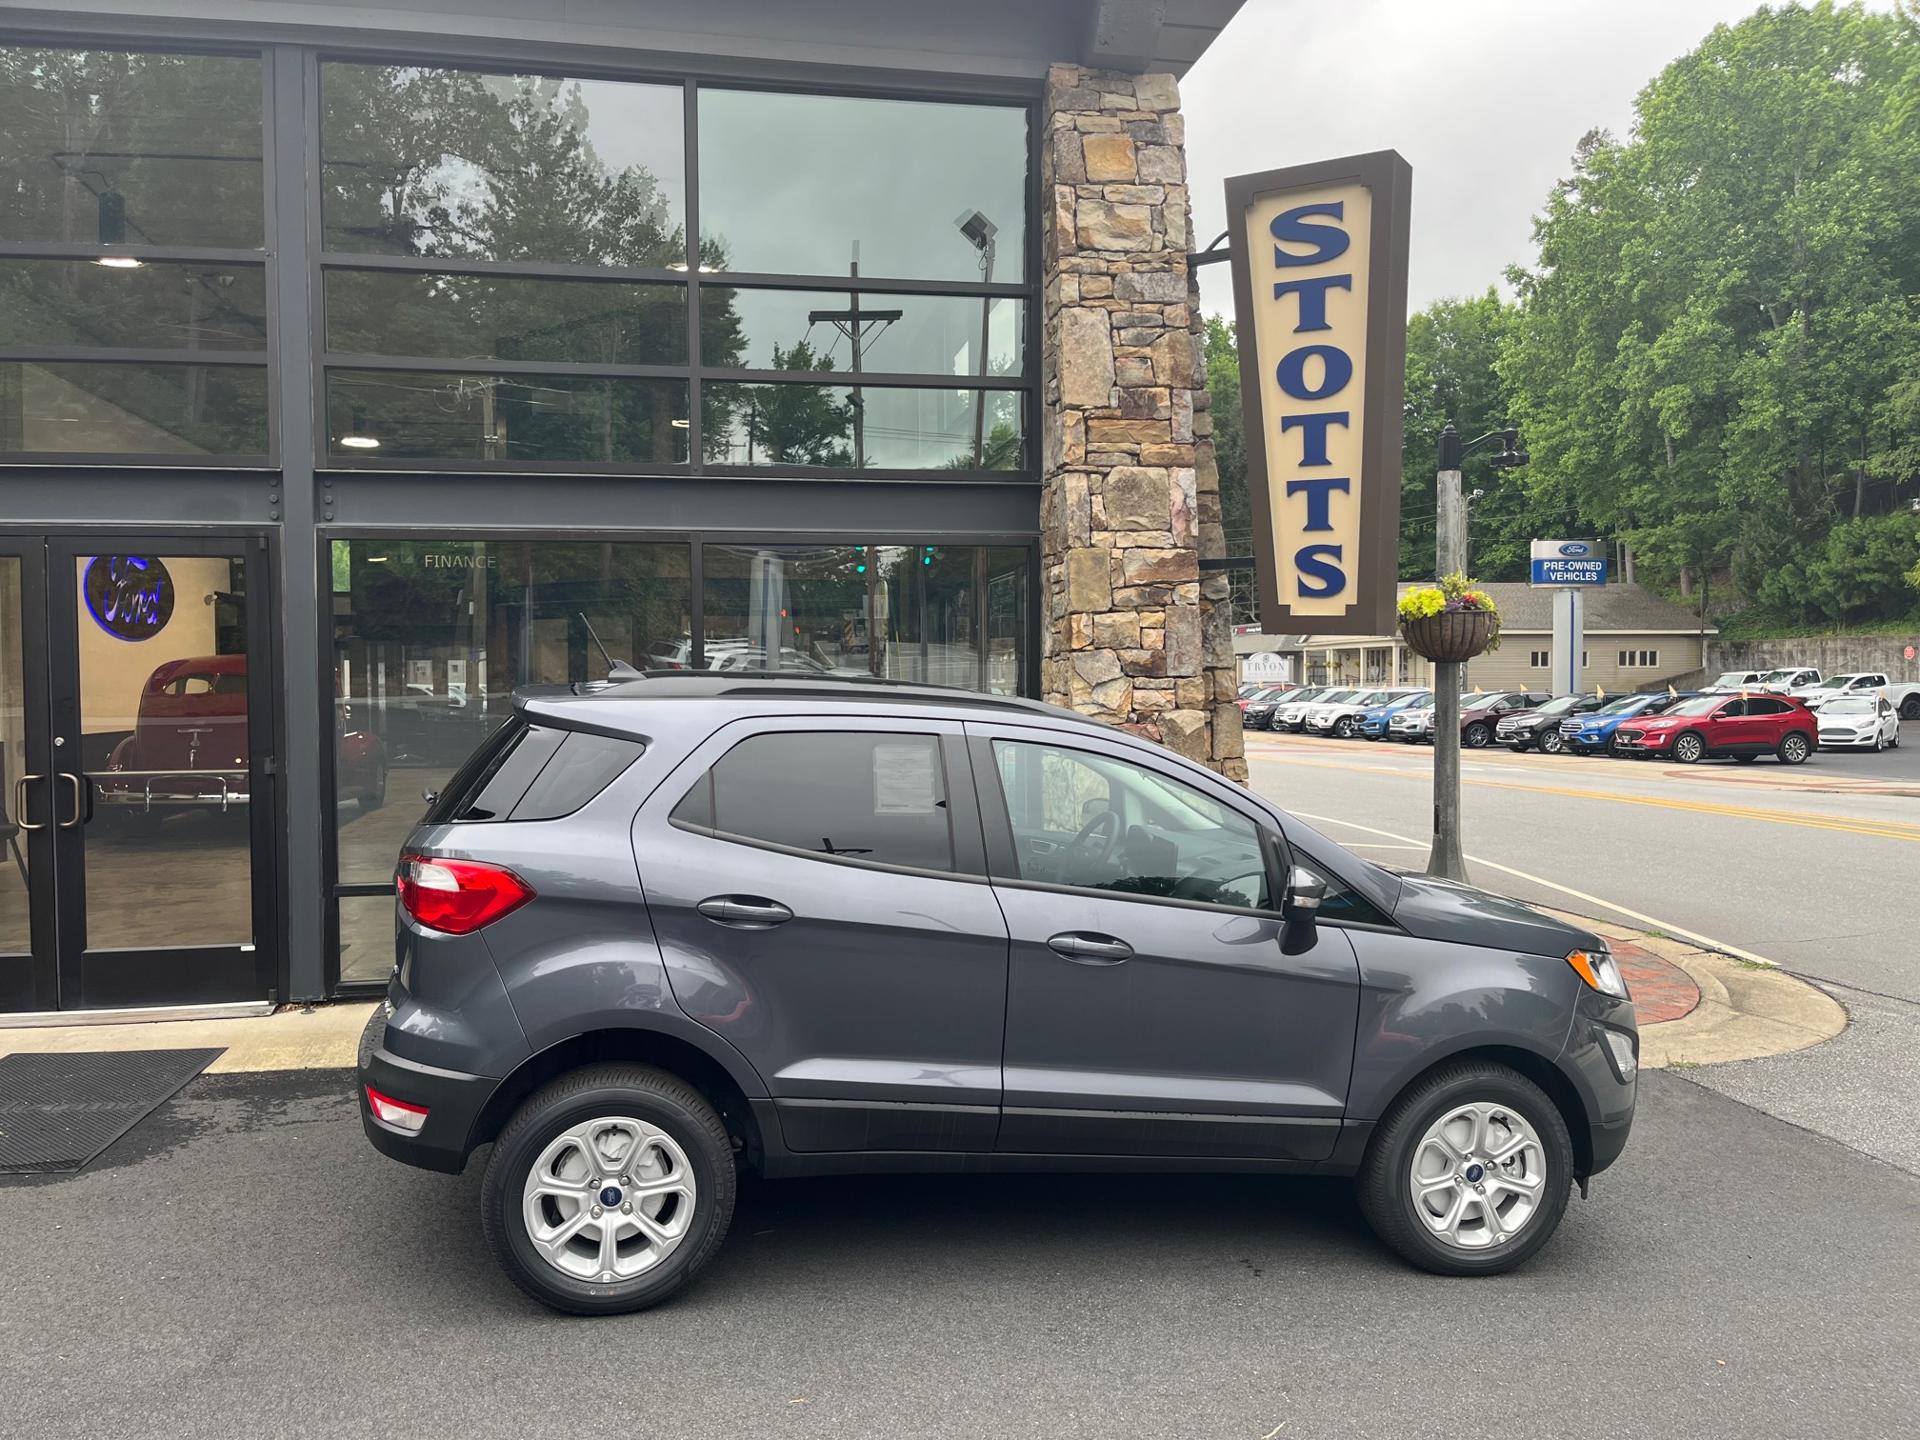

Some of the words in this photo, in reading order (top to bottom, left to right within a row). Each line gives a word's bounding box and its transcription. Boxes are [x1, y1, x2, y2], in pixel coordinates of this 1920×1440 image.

[1269, 200, 1353, 598] STOTTS
[1566, 545, 1585, 554] Ford
[424, 554, 497, 569] FINANCE
[1543, 561, 1602, 571] PRE-OWNED
[1549, 571, 1598, 581] VEHICLES
[1245, 662, 1286, 672] TRYON
